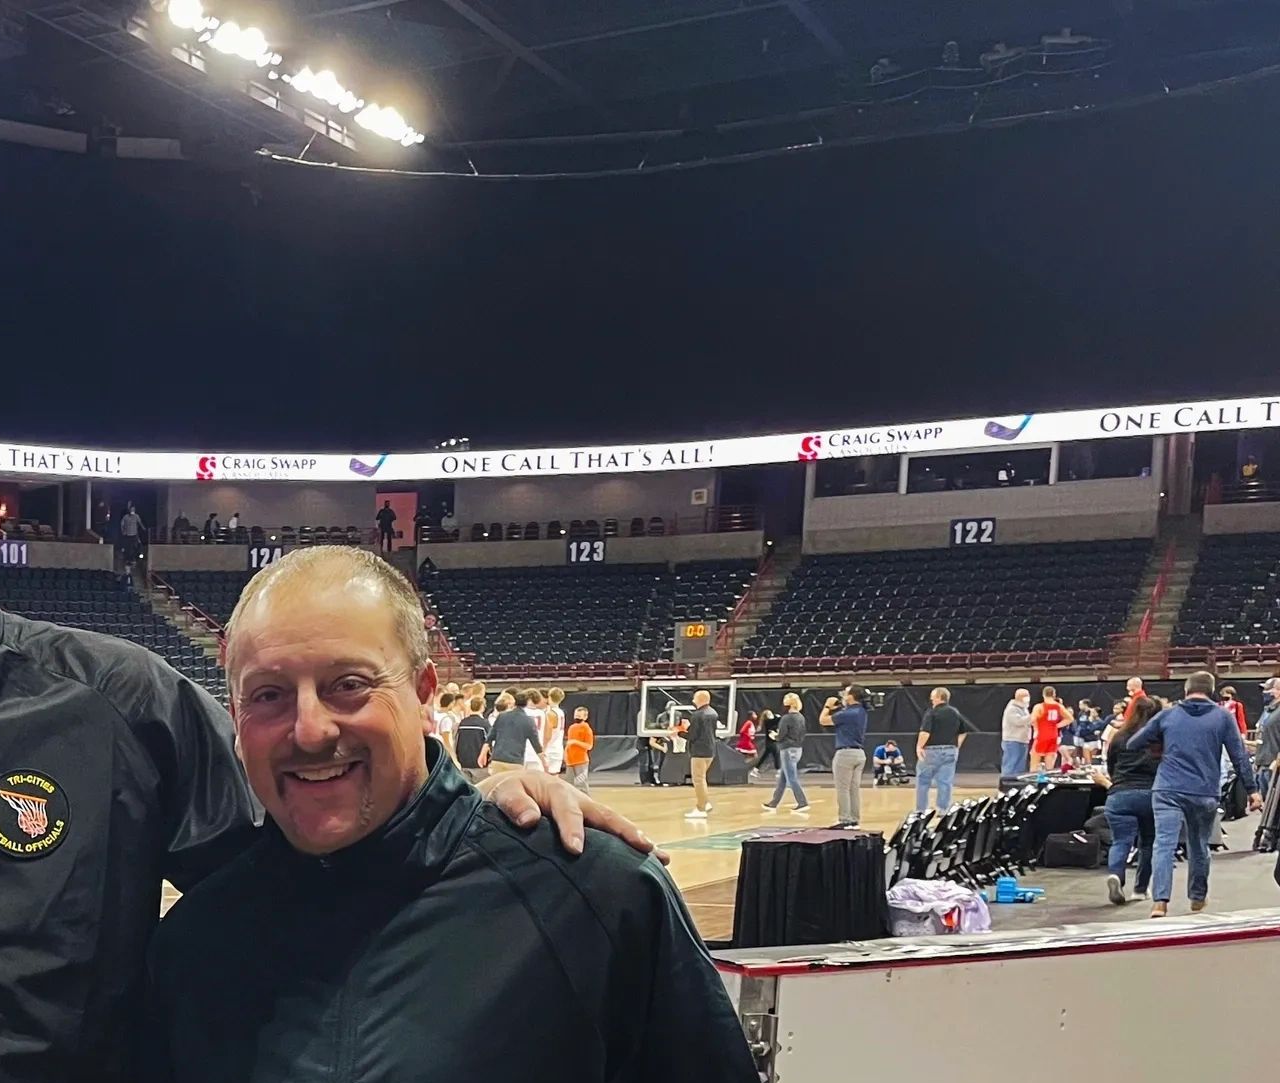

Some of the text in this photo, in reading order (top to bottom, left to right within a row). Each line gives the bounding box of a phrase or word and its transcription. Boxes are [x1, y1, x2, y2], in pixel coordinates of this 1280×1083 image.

[1100, 412, 1161, 432] ONE
[1174, 407, 1248, 427] CALL
[828, 427, 943, 447] CRAIG SWAPP
[9, 449, 74, 471] THAT'S
[80, 455, 121, 473] ALL!
[222, 456, 317, 470] CRAIG SWAPP
[441, 445, 714, 474] ONE CALL THAT'S ALL!
[954, 520, 994, 544] 122
[0, 543, 27, 565] 101
[569, 541, 605, 563] 123
[7, 774, 55, 794] TRI-CITIES
[25, 819, 65, 852] OFFICIALS
